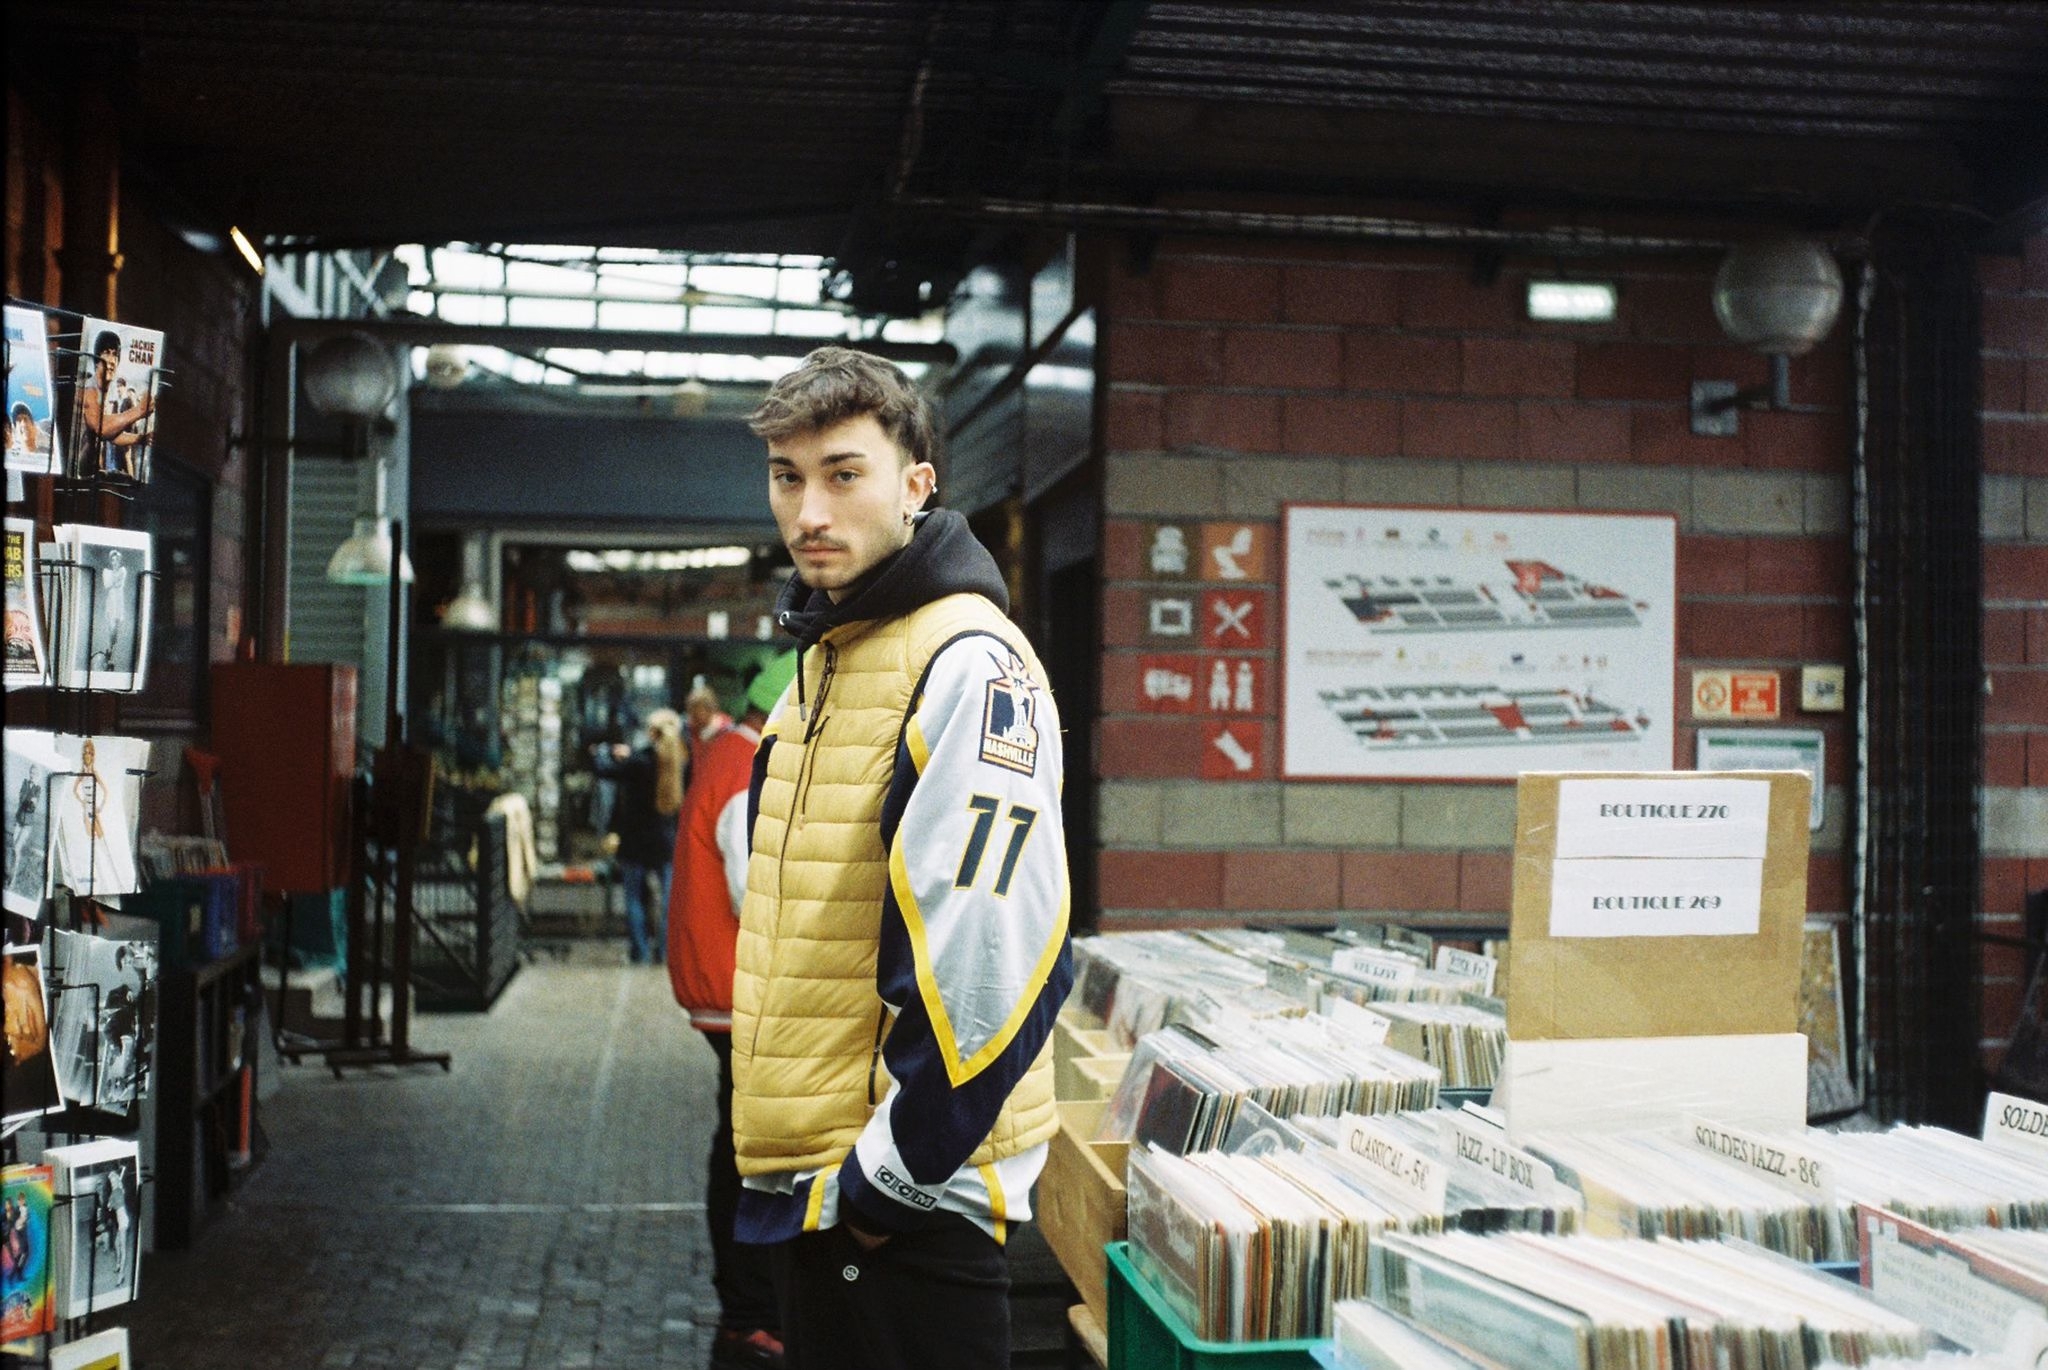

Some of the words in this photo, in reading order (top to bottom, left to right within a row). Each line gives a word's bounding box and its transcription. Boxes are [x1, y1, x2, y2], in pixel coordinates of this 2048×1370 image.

[129, 349, 154, 366] CHAN
[130, 338, 155, 352] JACKIE
[983, 737, 1035, 768] NASHVILLE
[1600, 803, 1694, 818] BOUTIQUE
[1697, 804, 1730, 819] 270
[1592, 895, 1686, 910] BOUTIQUE
[1689, 895, 1722, 910] 269
[1350, 1128, 1403, 1177] CLASSICAL
[1456, 1131, 1484, 1165] JAZZ
[1491, 1147, 1507, 1176] LP
[1508, 1155, 1535, 1190] BOX
[1695, 1125, 1748, 1163] SOLDES
[1750, 1143, 1787, 1177] JAZZ
[876, 1167, 936, 1208] CCM
